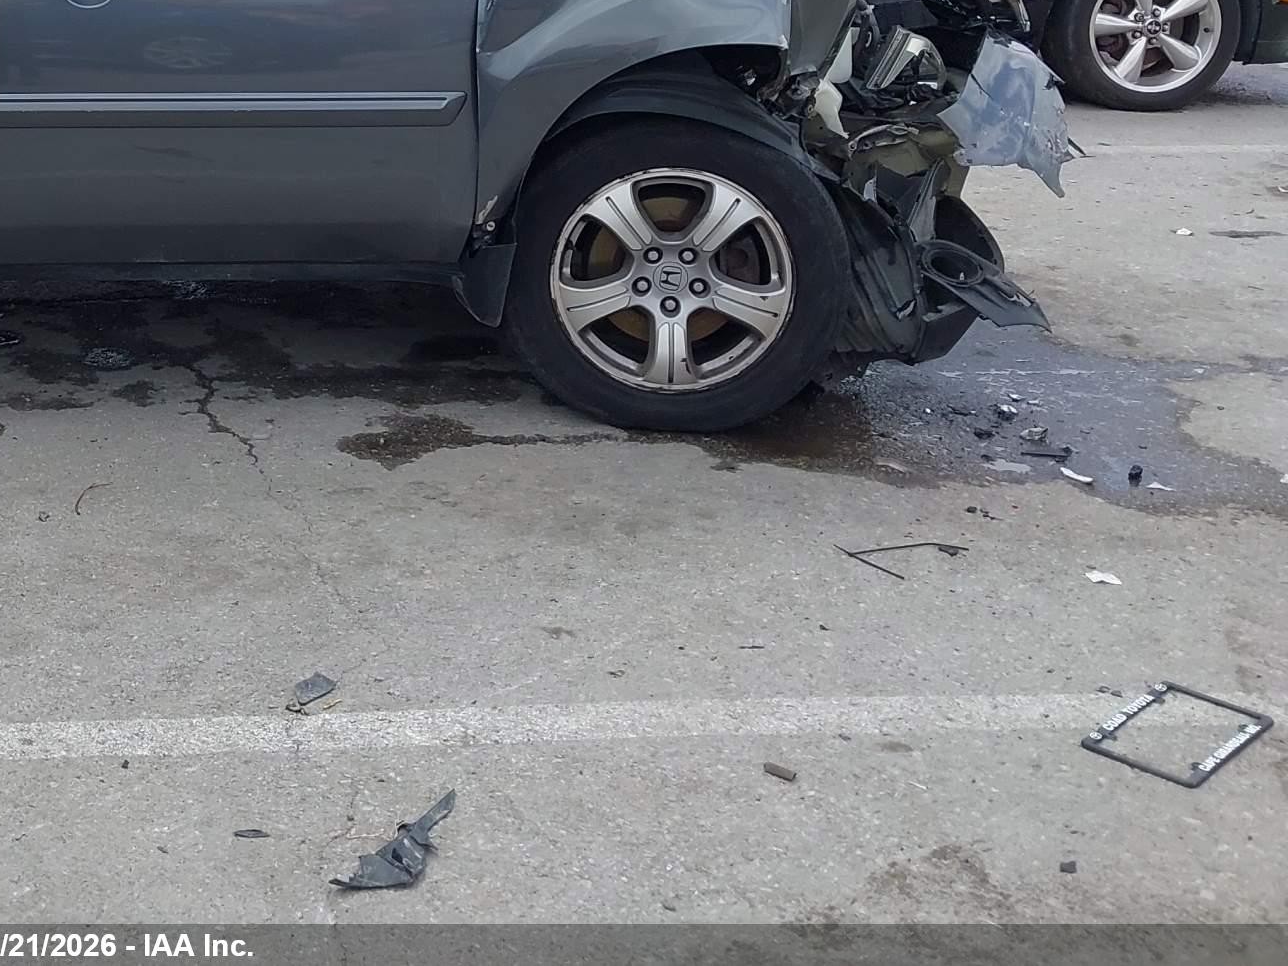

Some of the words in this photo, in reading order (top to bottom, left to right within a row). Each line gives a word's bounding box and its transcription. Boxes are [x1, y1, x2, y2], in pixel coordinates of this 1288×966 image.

[1102, 713, 1127, 731] COAD
[1121, 694, 1155, 715] TOYOTA
[1198, 755, 1220, 772] CAPE
